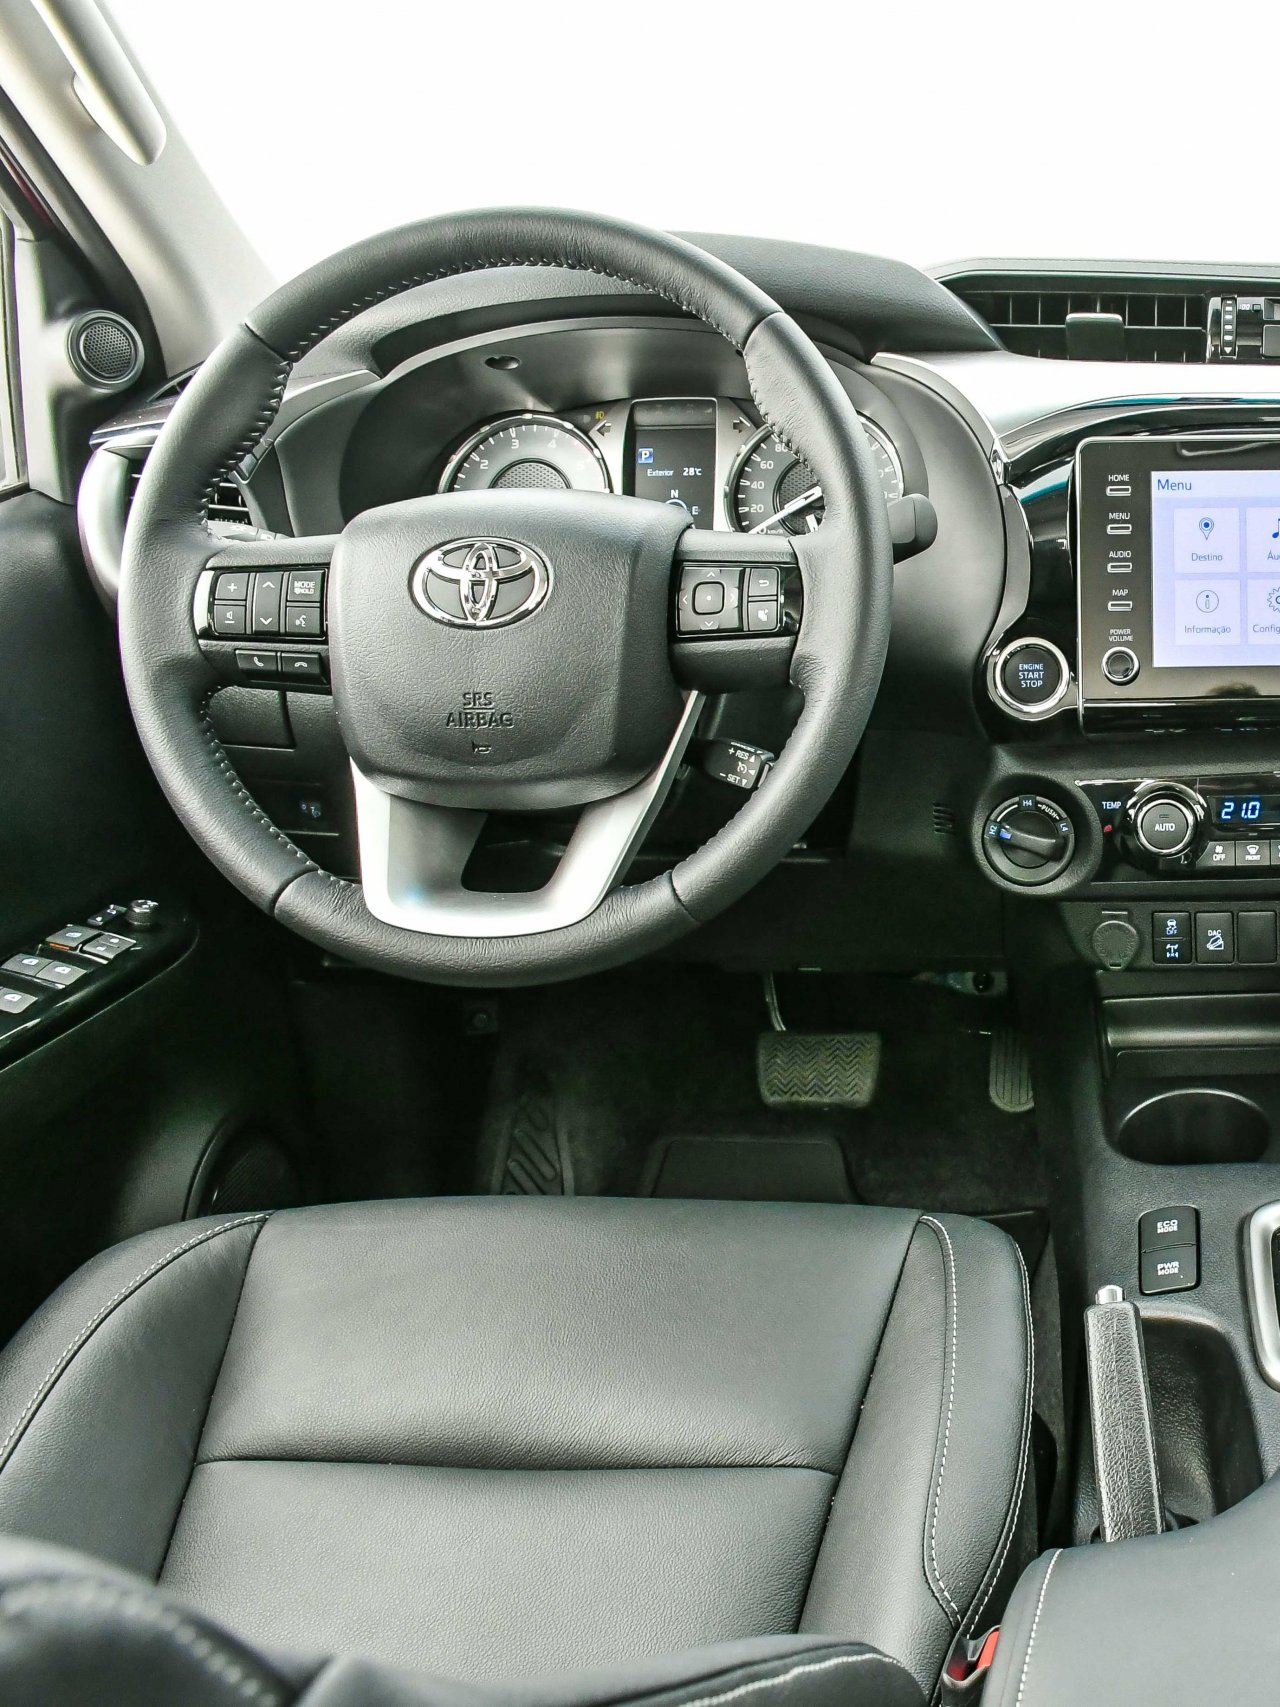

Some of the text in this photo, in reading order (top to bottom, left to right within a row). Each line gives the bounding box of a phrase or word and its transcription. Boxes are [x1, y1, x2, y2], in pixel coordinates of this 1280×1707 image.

[511, 439, 520, 449] 3
[547, 439, 557, 449] 4
[641, 451, 650, 461] P
[480, 460, 489, 469] 2
[760, 461, 774, 470] 60
[647, 469, 674, 477] Exterior
[1108, 474, 1130, 482] HOME
[750, 481, 764, 490] 40
[1157, 479, 1192, 491] Menu
[671, 490, 679, 499] N
[692, 506, 699, 515] E
[750, 504, 764, 513] 20
[1108, 512, 1131, 520] MENU
[1109, 550, 1132, 558] AUDIO
[1191, 552, 1223, 562] Destino
[294, 580, 316, 588] MODE
[1184, 624, 1231, 636] Informação
[1018, 663, 1044, 671] ENGINE
[1018, 672, 1045, 680] START
[1020, 680, 1043, 688] STOP
[463, 692, 494, 708] SRS
[446, 711, 514, 729] AIRBAG
[1022, 799, 1033, 807] H4
[1101, 801, 1122, 810] TEMP
[1221, 801, 1260, 819] 21.0
[988, 825, 998, 835] H2
[1059, 822, 1069, 832] L4
[1154, 823, 1176, 832] AUTO
[1212, 853, 1226, 862] OFF
[1207, 929, 1222, 937] DAC
[1157, 1220, 1178, 1228] ECO
[1157, 1225, 1178, 1234] MODE
[1157, 1261, 1180, 1270] PWR
[1157, 1268, 1179, 1276] MODE
